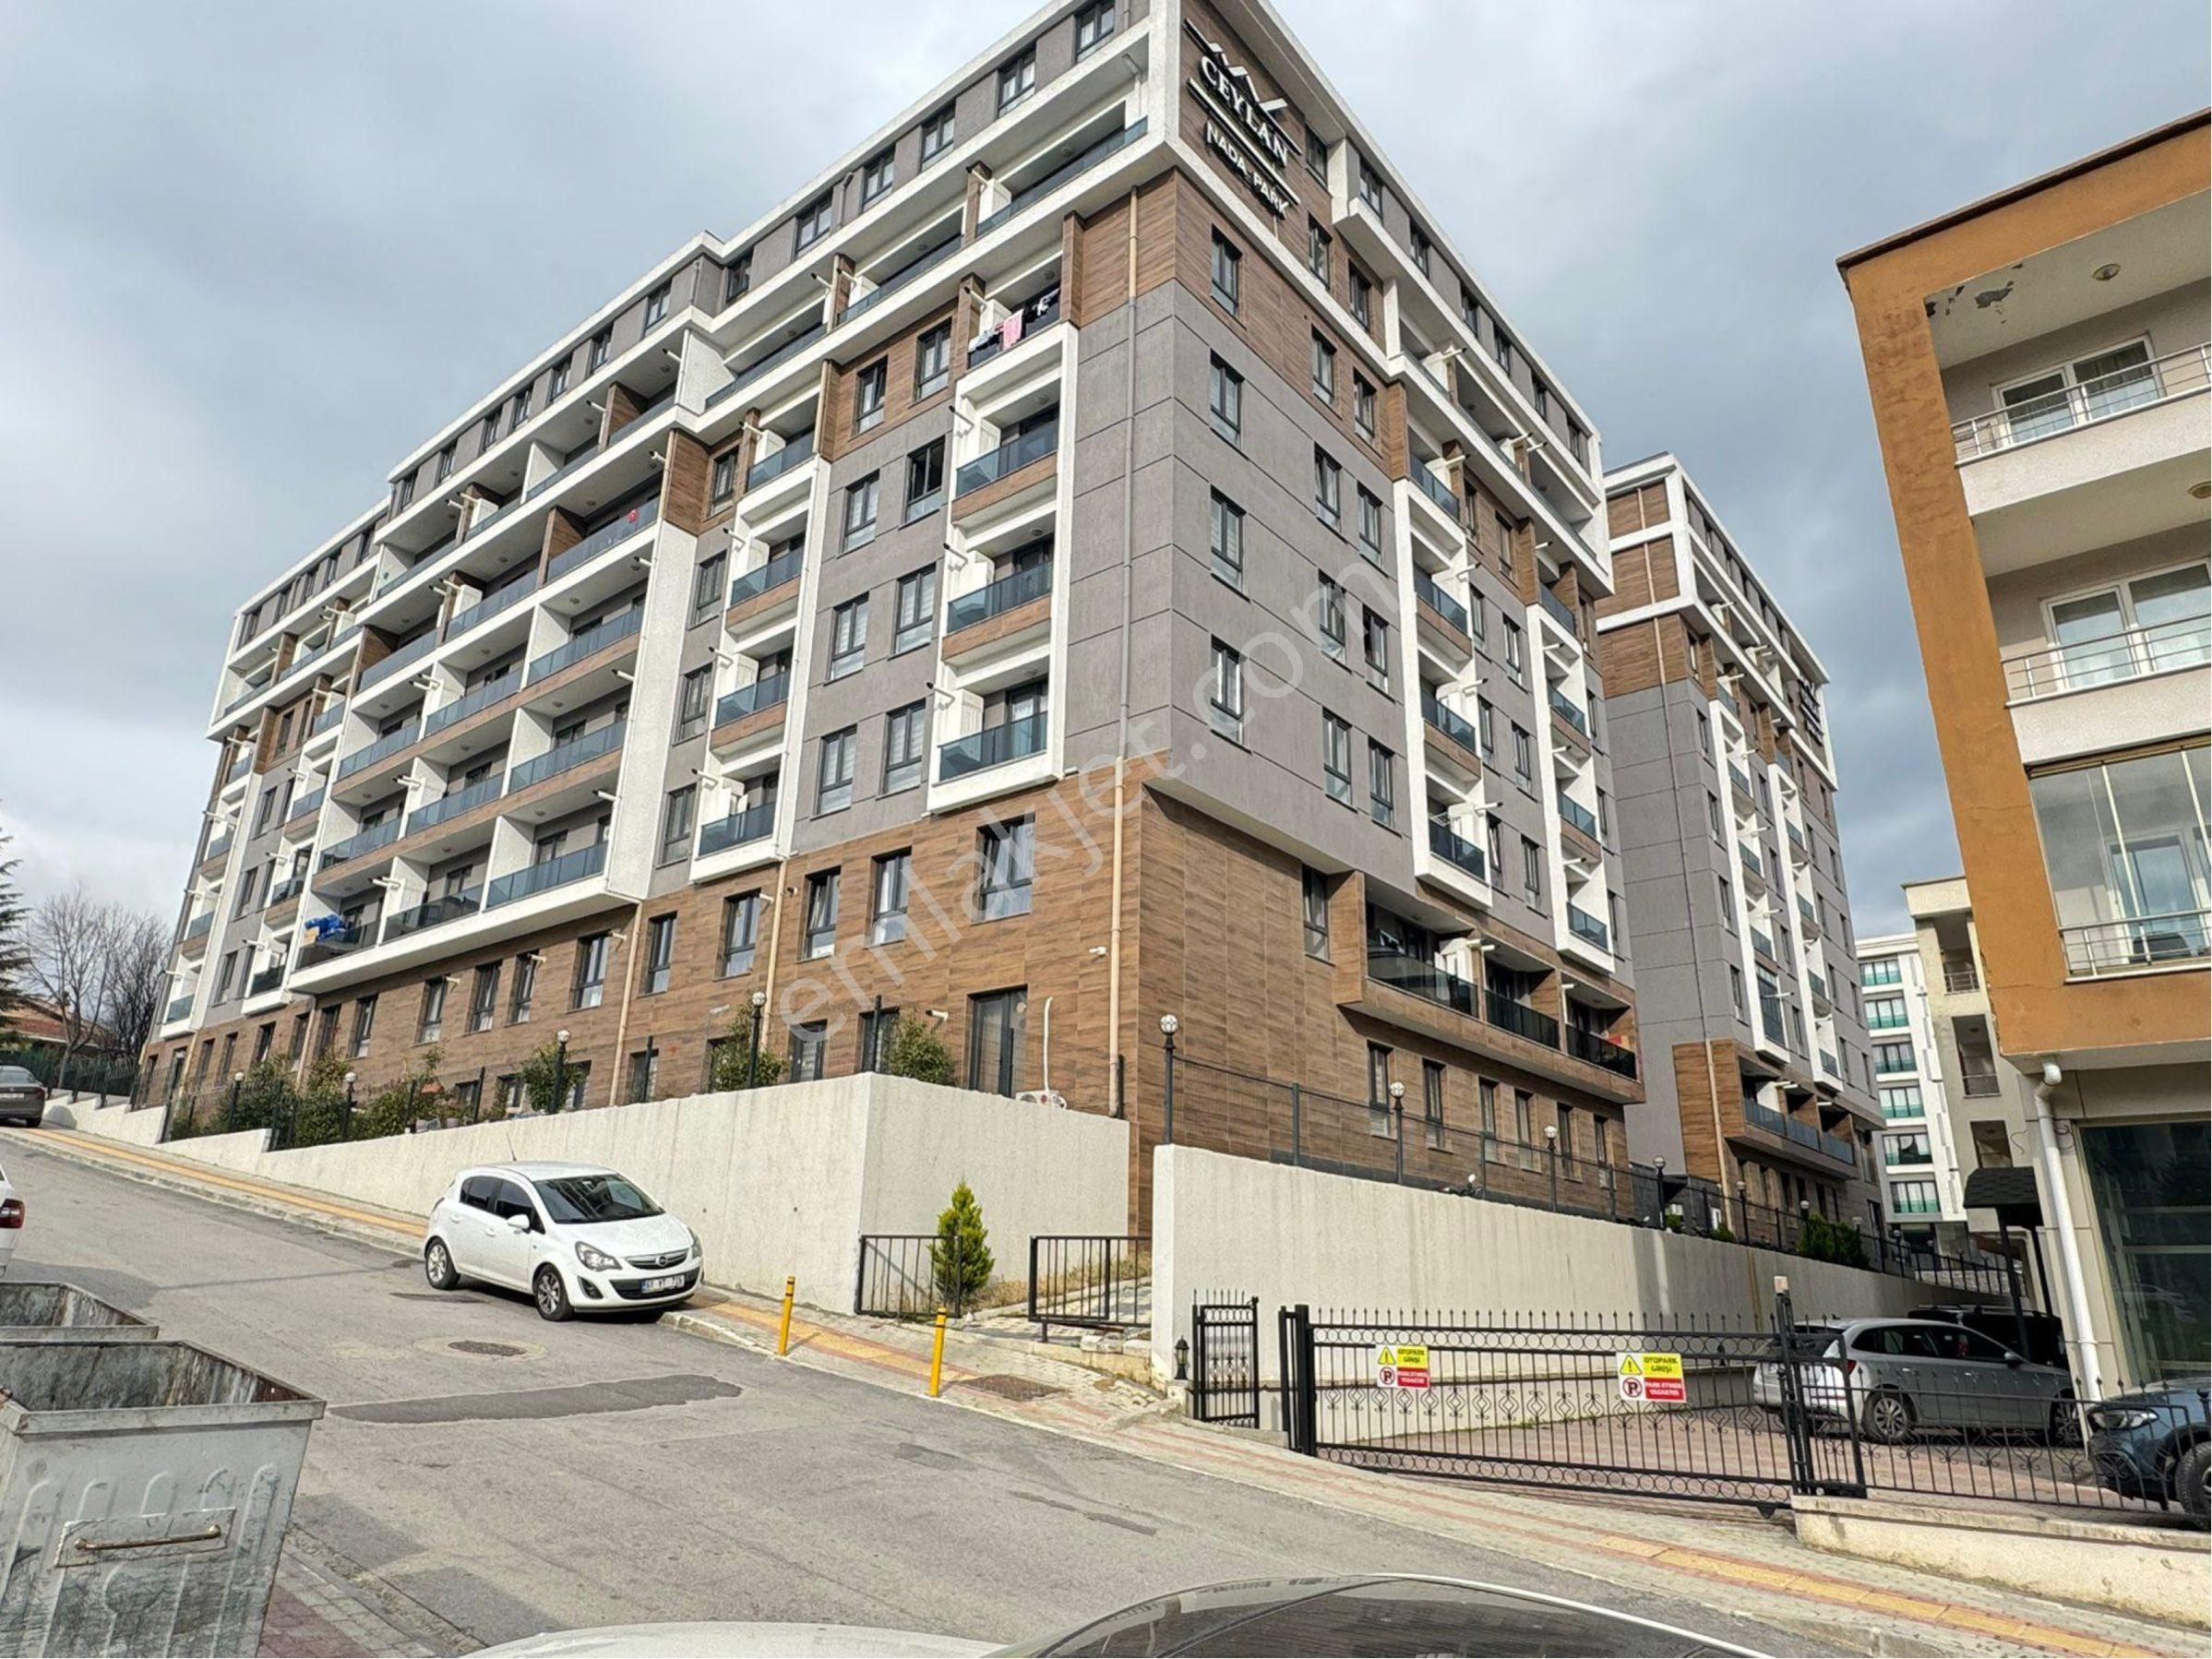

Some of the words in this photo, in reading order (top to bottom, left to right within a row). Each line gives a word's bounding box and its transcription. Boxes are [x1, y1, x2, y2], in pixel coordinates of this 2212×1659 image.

[1201, 55, 1288, 169] CEYLAN
[1205, 119, 1248, 176] NADA
[1253, 171, 1289, 215] PARK
[1644, 1356, 1678, 1365] OTOPARK
